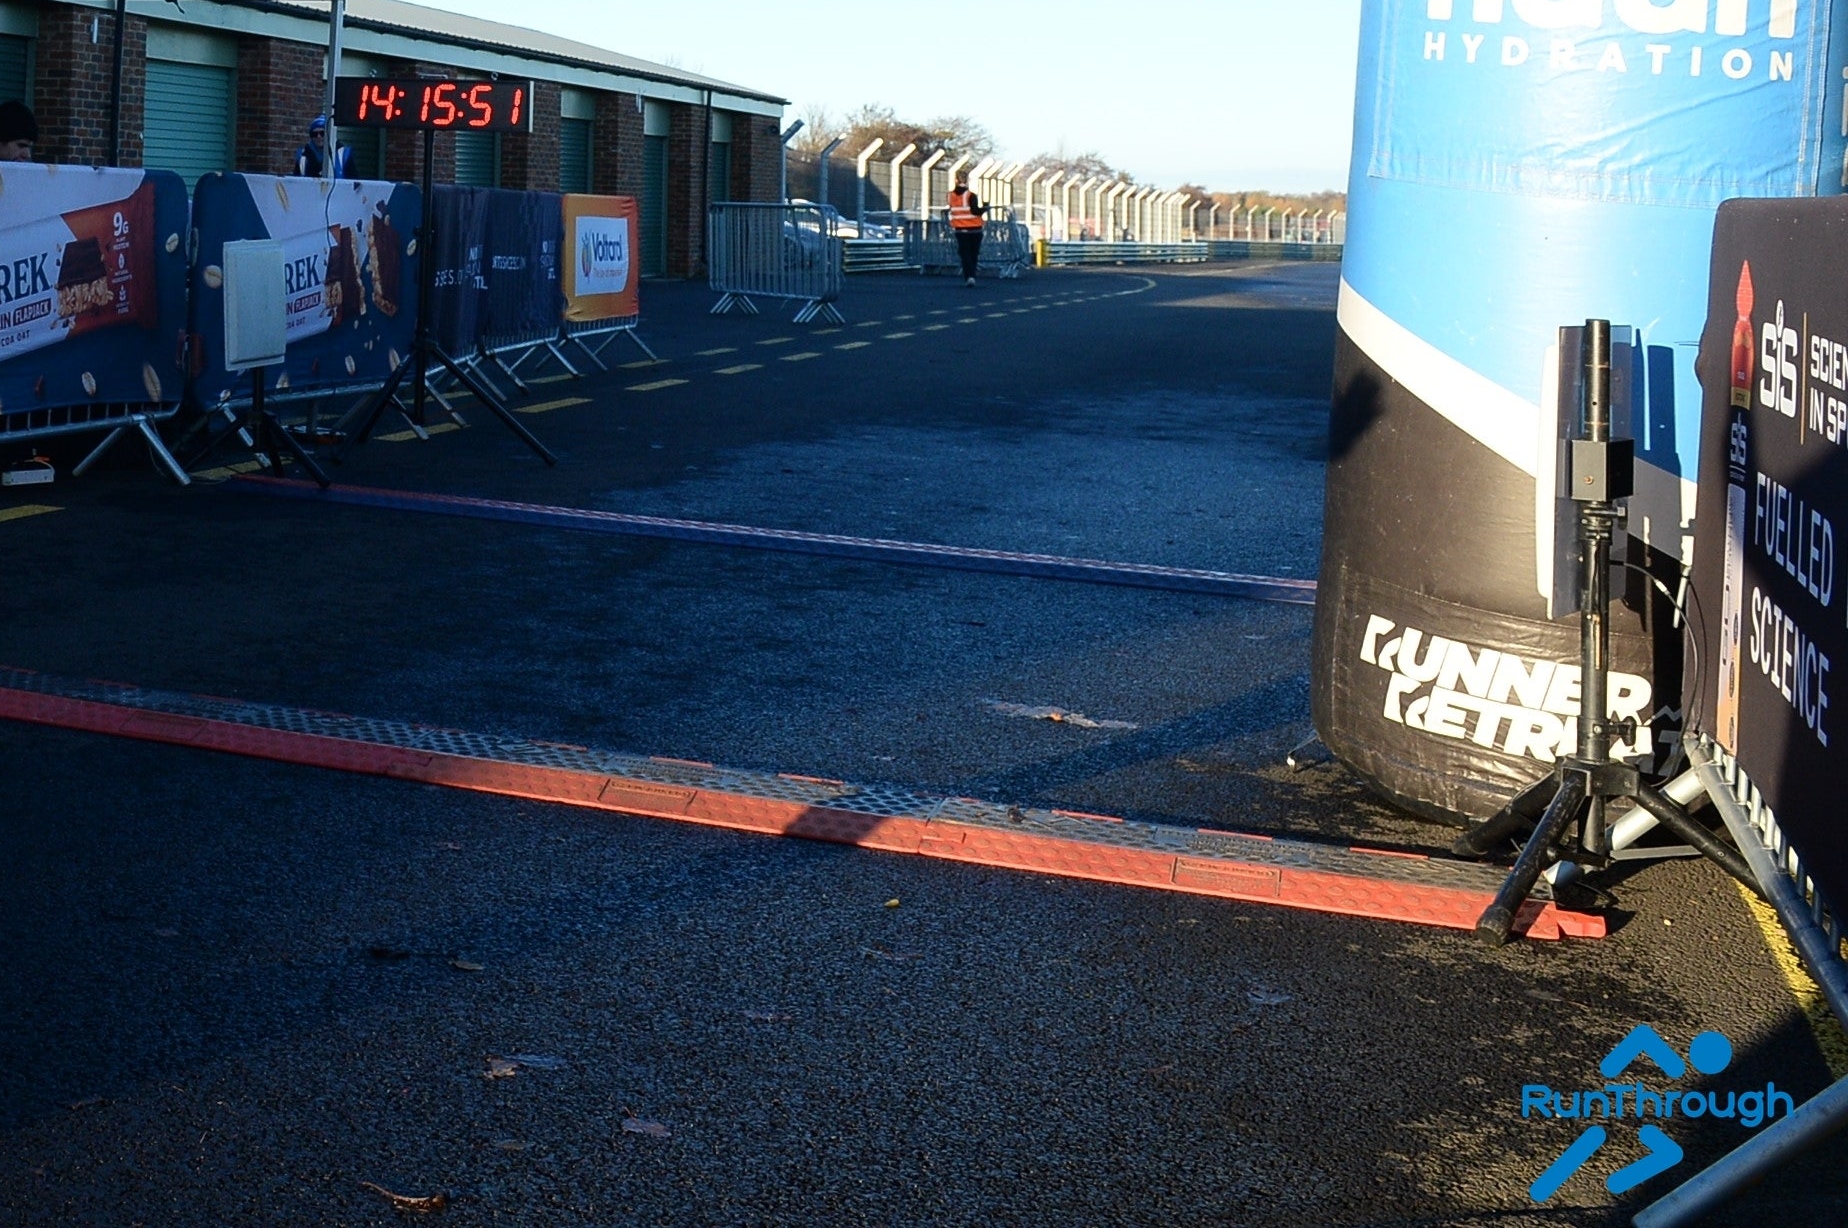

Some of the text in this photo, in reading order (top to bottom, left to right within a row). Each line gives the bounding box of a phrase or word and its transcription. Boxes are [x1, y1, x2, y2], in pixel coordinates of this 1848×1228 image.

[1423, 30, 1793, 82] HYDRATION
[359, 84, 522, 126] 14:15:51
[14, 300, 50, 324] FLAPJACK
[17, 329, 31, 342] OAT
[1760, 299, 1798, 418] SiS
[1809, 386, 1824, 435] IN
[1754, 472, 1834, 607] FUELLED
[1359, 613, 1652, 727] RUNNER
[1750, 586, 1830, 748] SCIENCE
